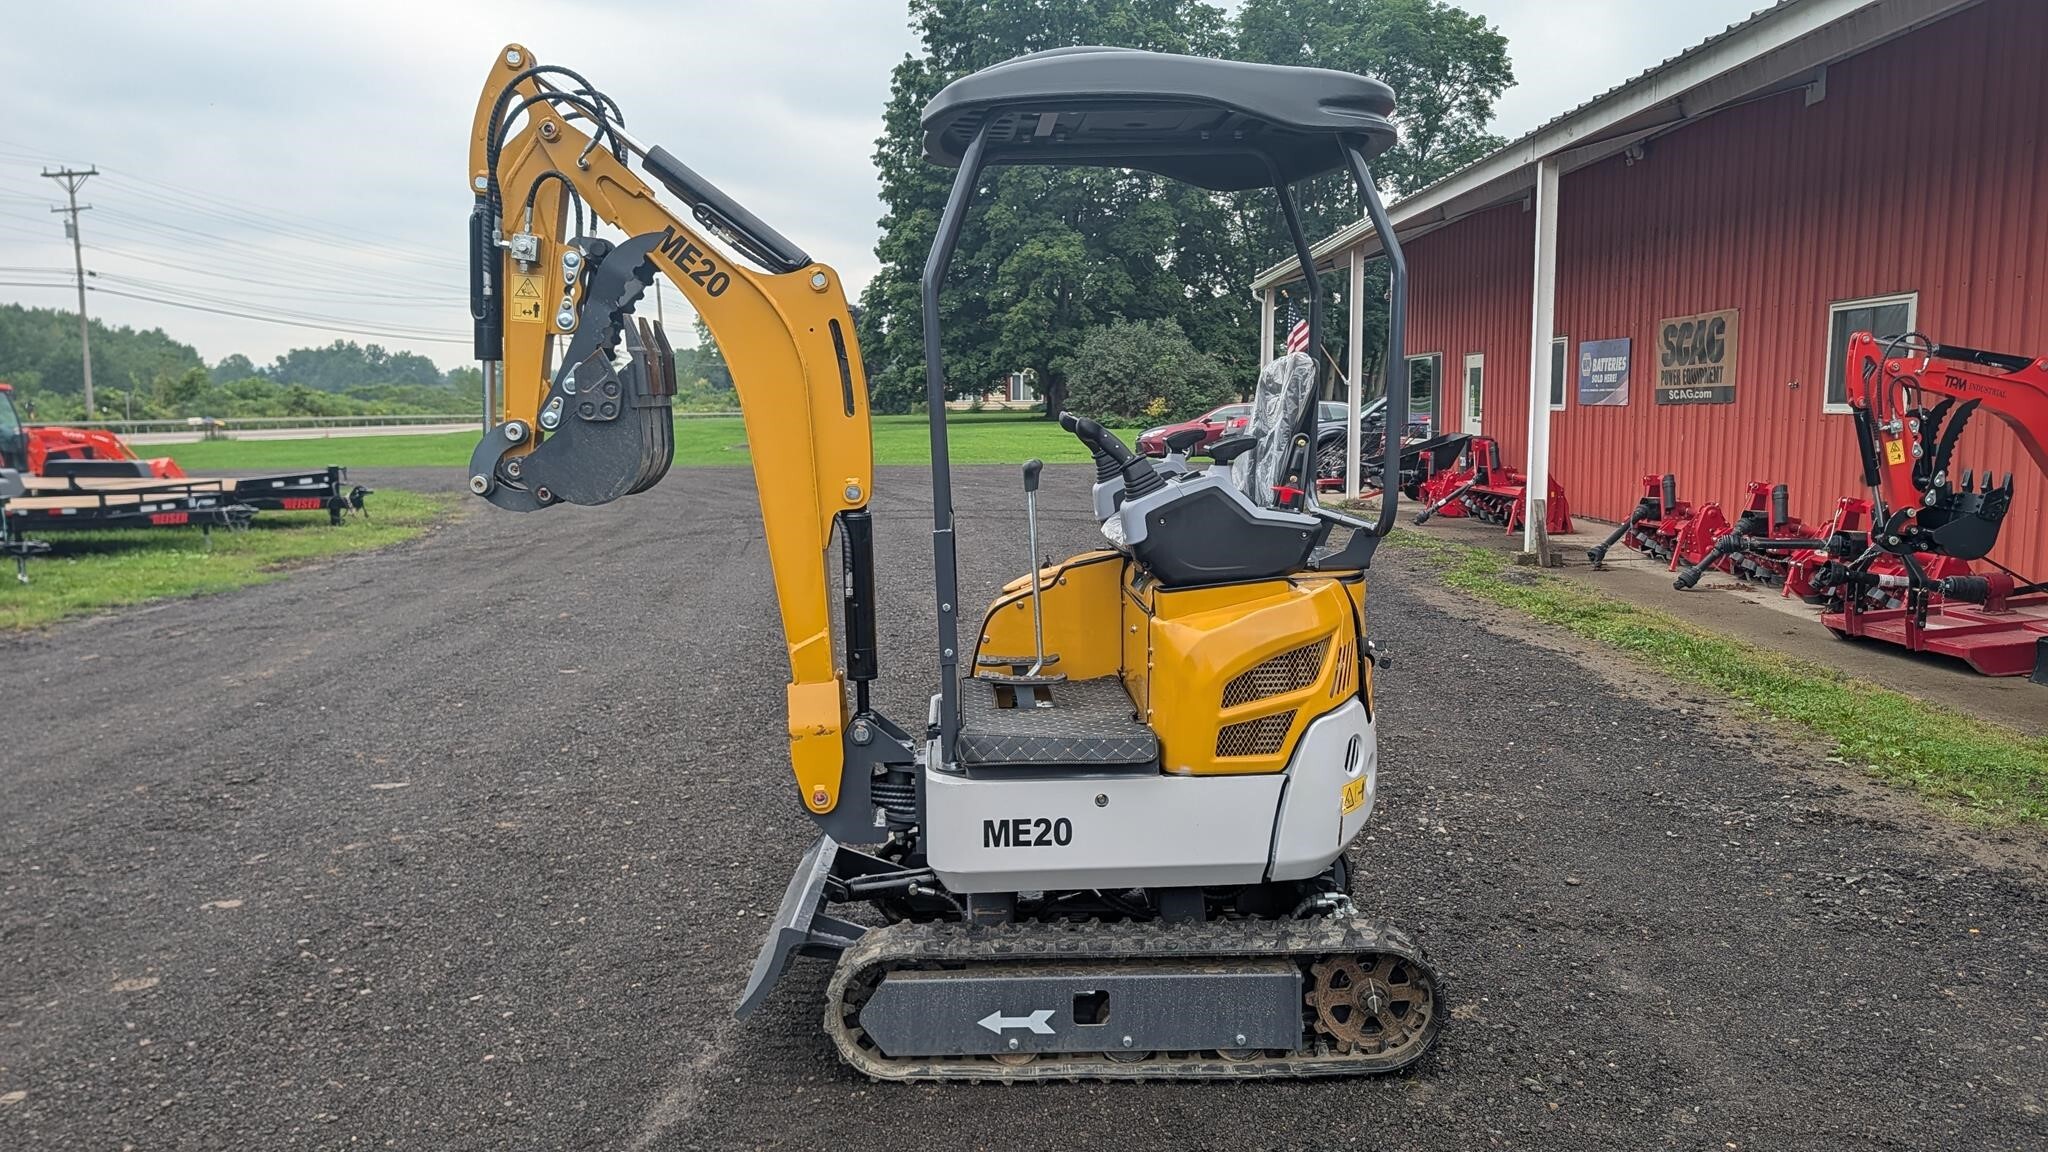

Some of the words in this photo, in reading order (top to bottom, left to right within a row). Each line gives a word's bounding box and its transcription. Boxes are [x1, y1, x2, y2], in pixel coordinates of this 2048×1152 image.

[661, 225, 730, 297] ME20
[1661, 316, 1725, 367] SCAG
[1592, 356, 1626, 372] BATTERIES
[1591, 374, 1603, 383] SOLD
[1661, 369, 1681, 386] POWER
[1683, 366, 1724, 385] EQUIPMENT
[1668, 388, 1712, 400] SCAG.com
[1968, 382, 2007, 399] INDUSTRIAL
[983, 818, 1073, 848] ME20
